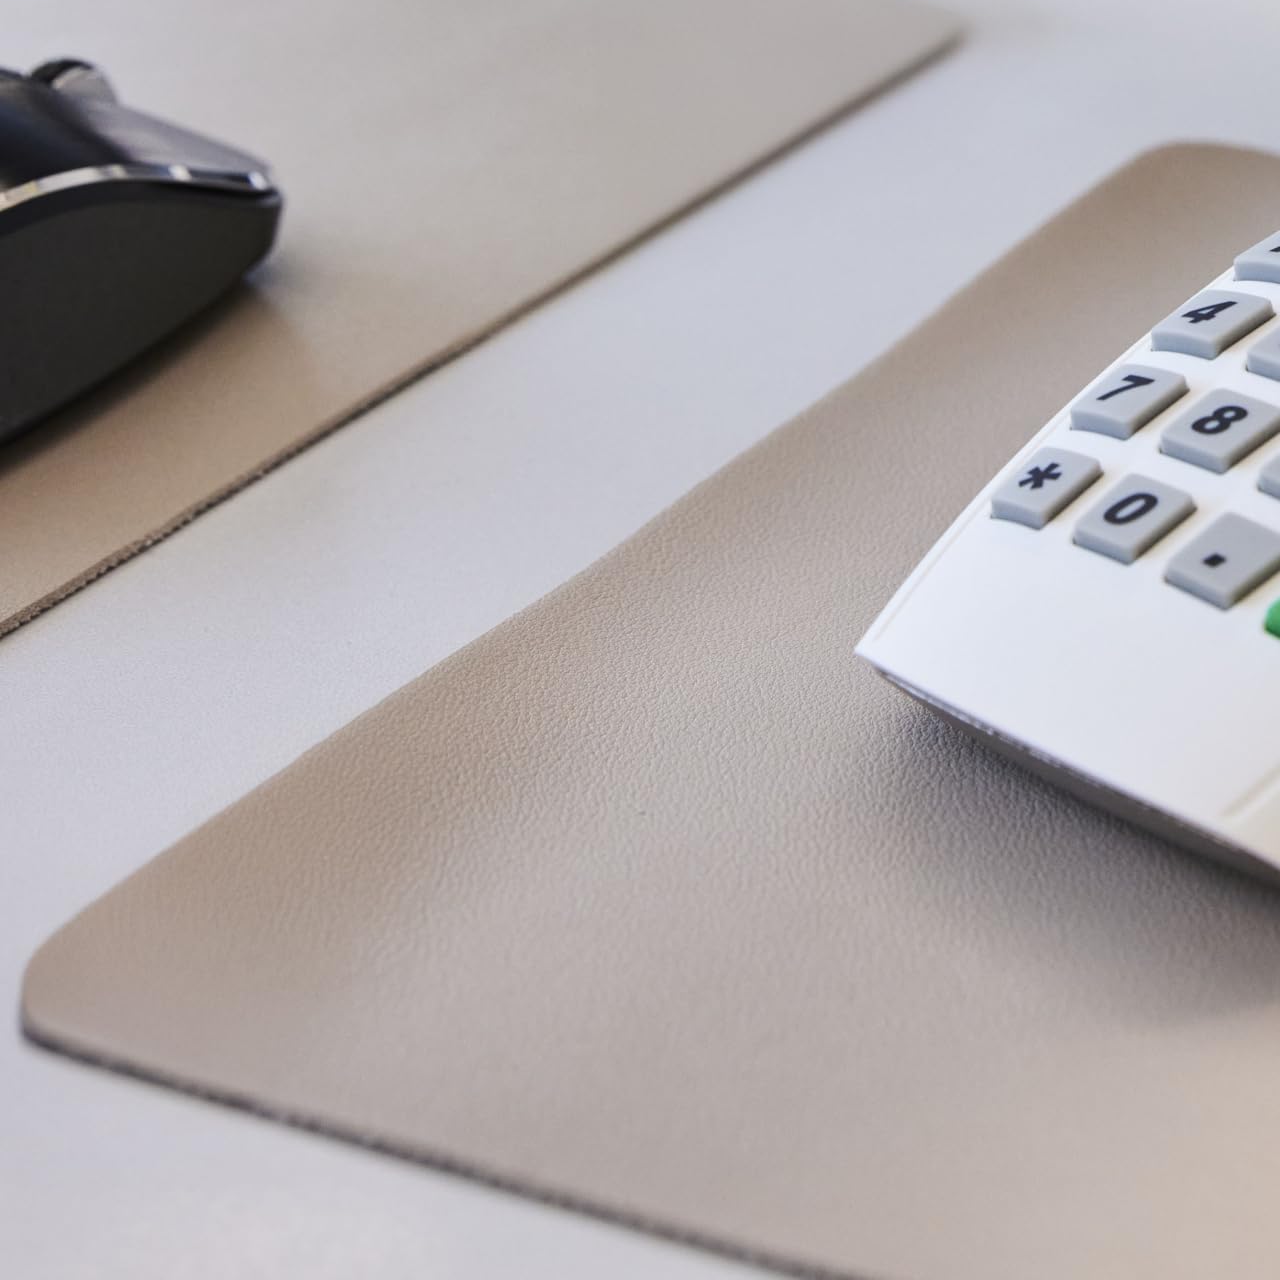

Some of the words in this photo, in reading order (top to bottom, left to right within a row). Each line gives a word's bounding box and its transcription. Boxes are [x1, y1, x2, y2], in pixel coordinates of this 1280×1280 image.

[1180, 300, 1238, 324] 4
[1096, 374, 1155, 401] 7
[1192, 405, 1249, 436] 8
[1103, 492, 1159, 526] 0
